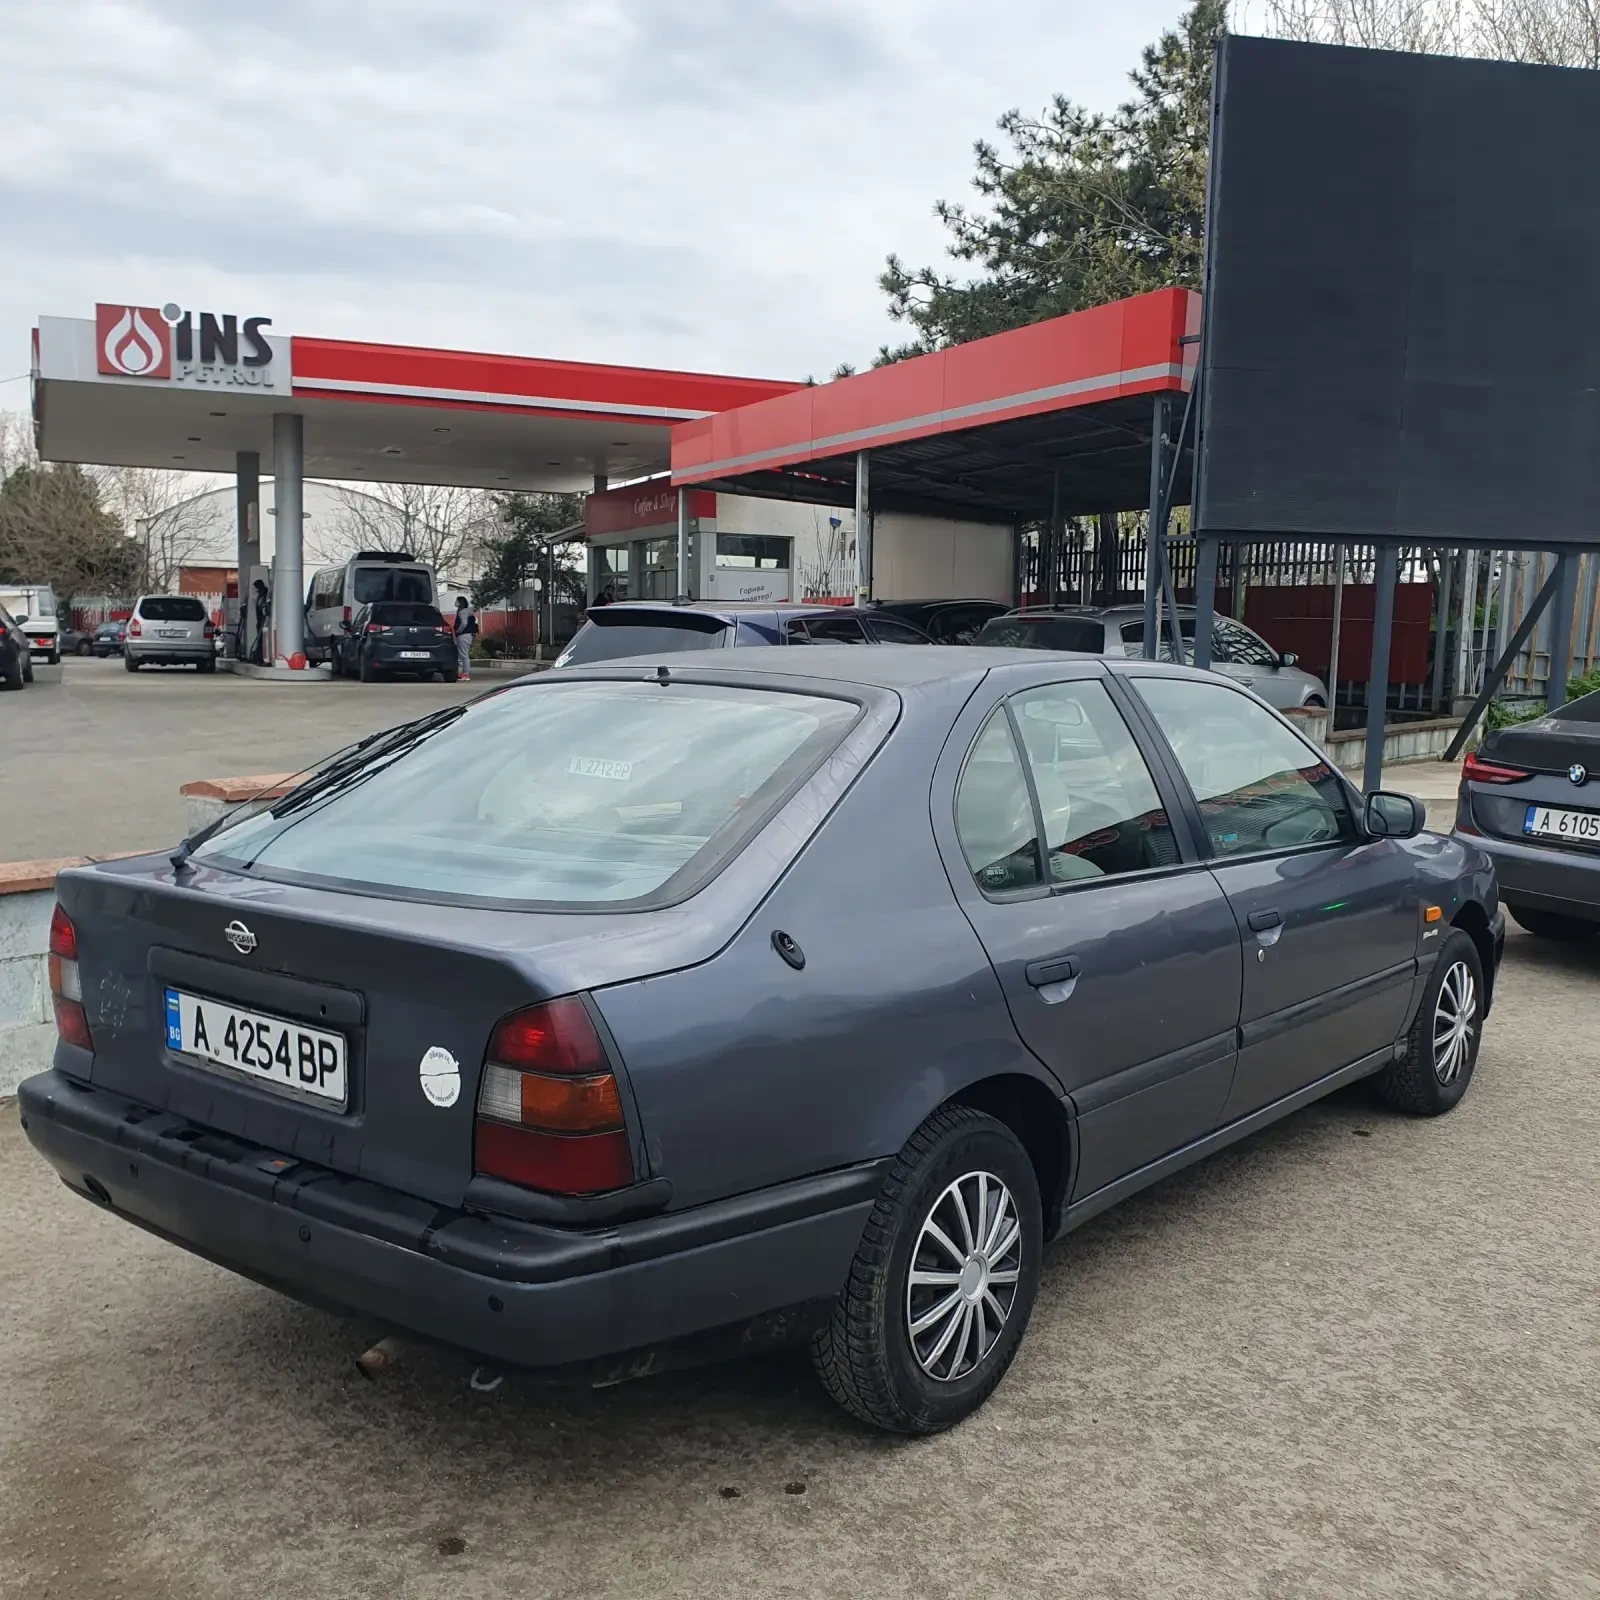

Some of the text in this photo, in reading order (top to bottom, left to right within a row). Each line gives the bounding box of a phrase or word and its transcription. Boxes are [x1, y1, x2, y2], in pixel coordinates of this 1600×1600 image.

[176, 364, 275, 388] PETROL
[634, 496, 653, 517] Coffee
[660, 492, 676, 512] Shop
[739, 585, 765, 595] Горива
[573, 758, 582, 773] A
[1540, 811, 1600, 837] A 6105
[169, 1026, 181, 1042] BG
[193, 1005, 211, 1053] A
